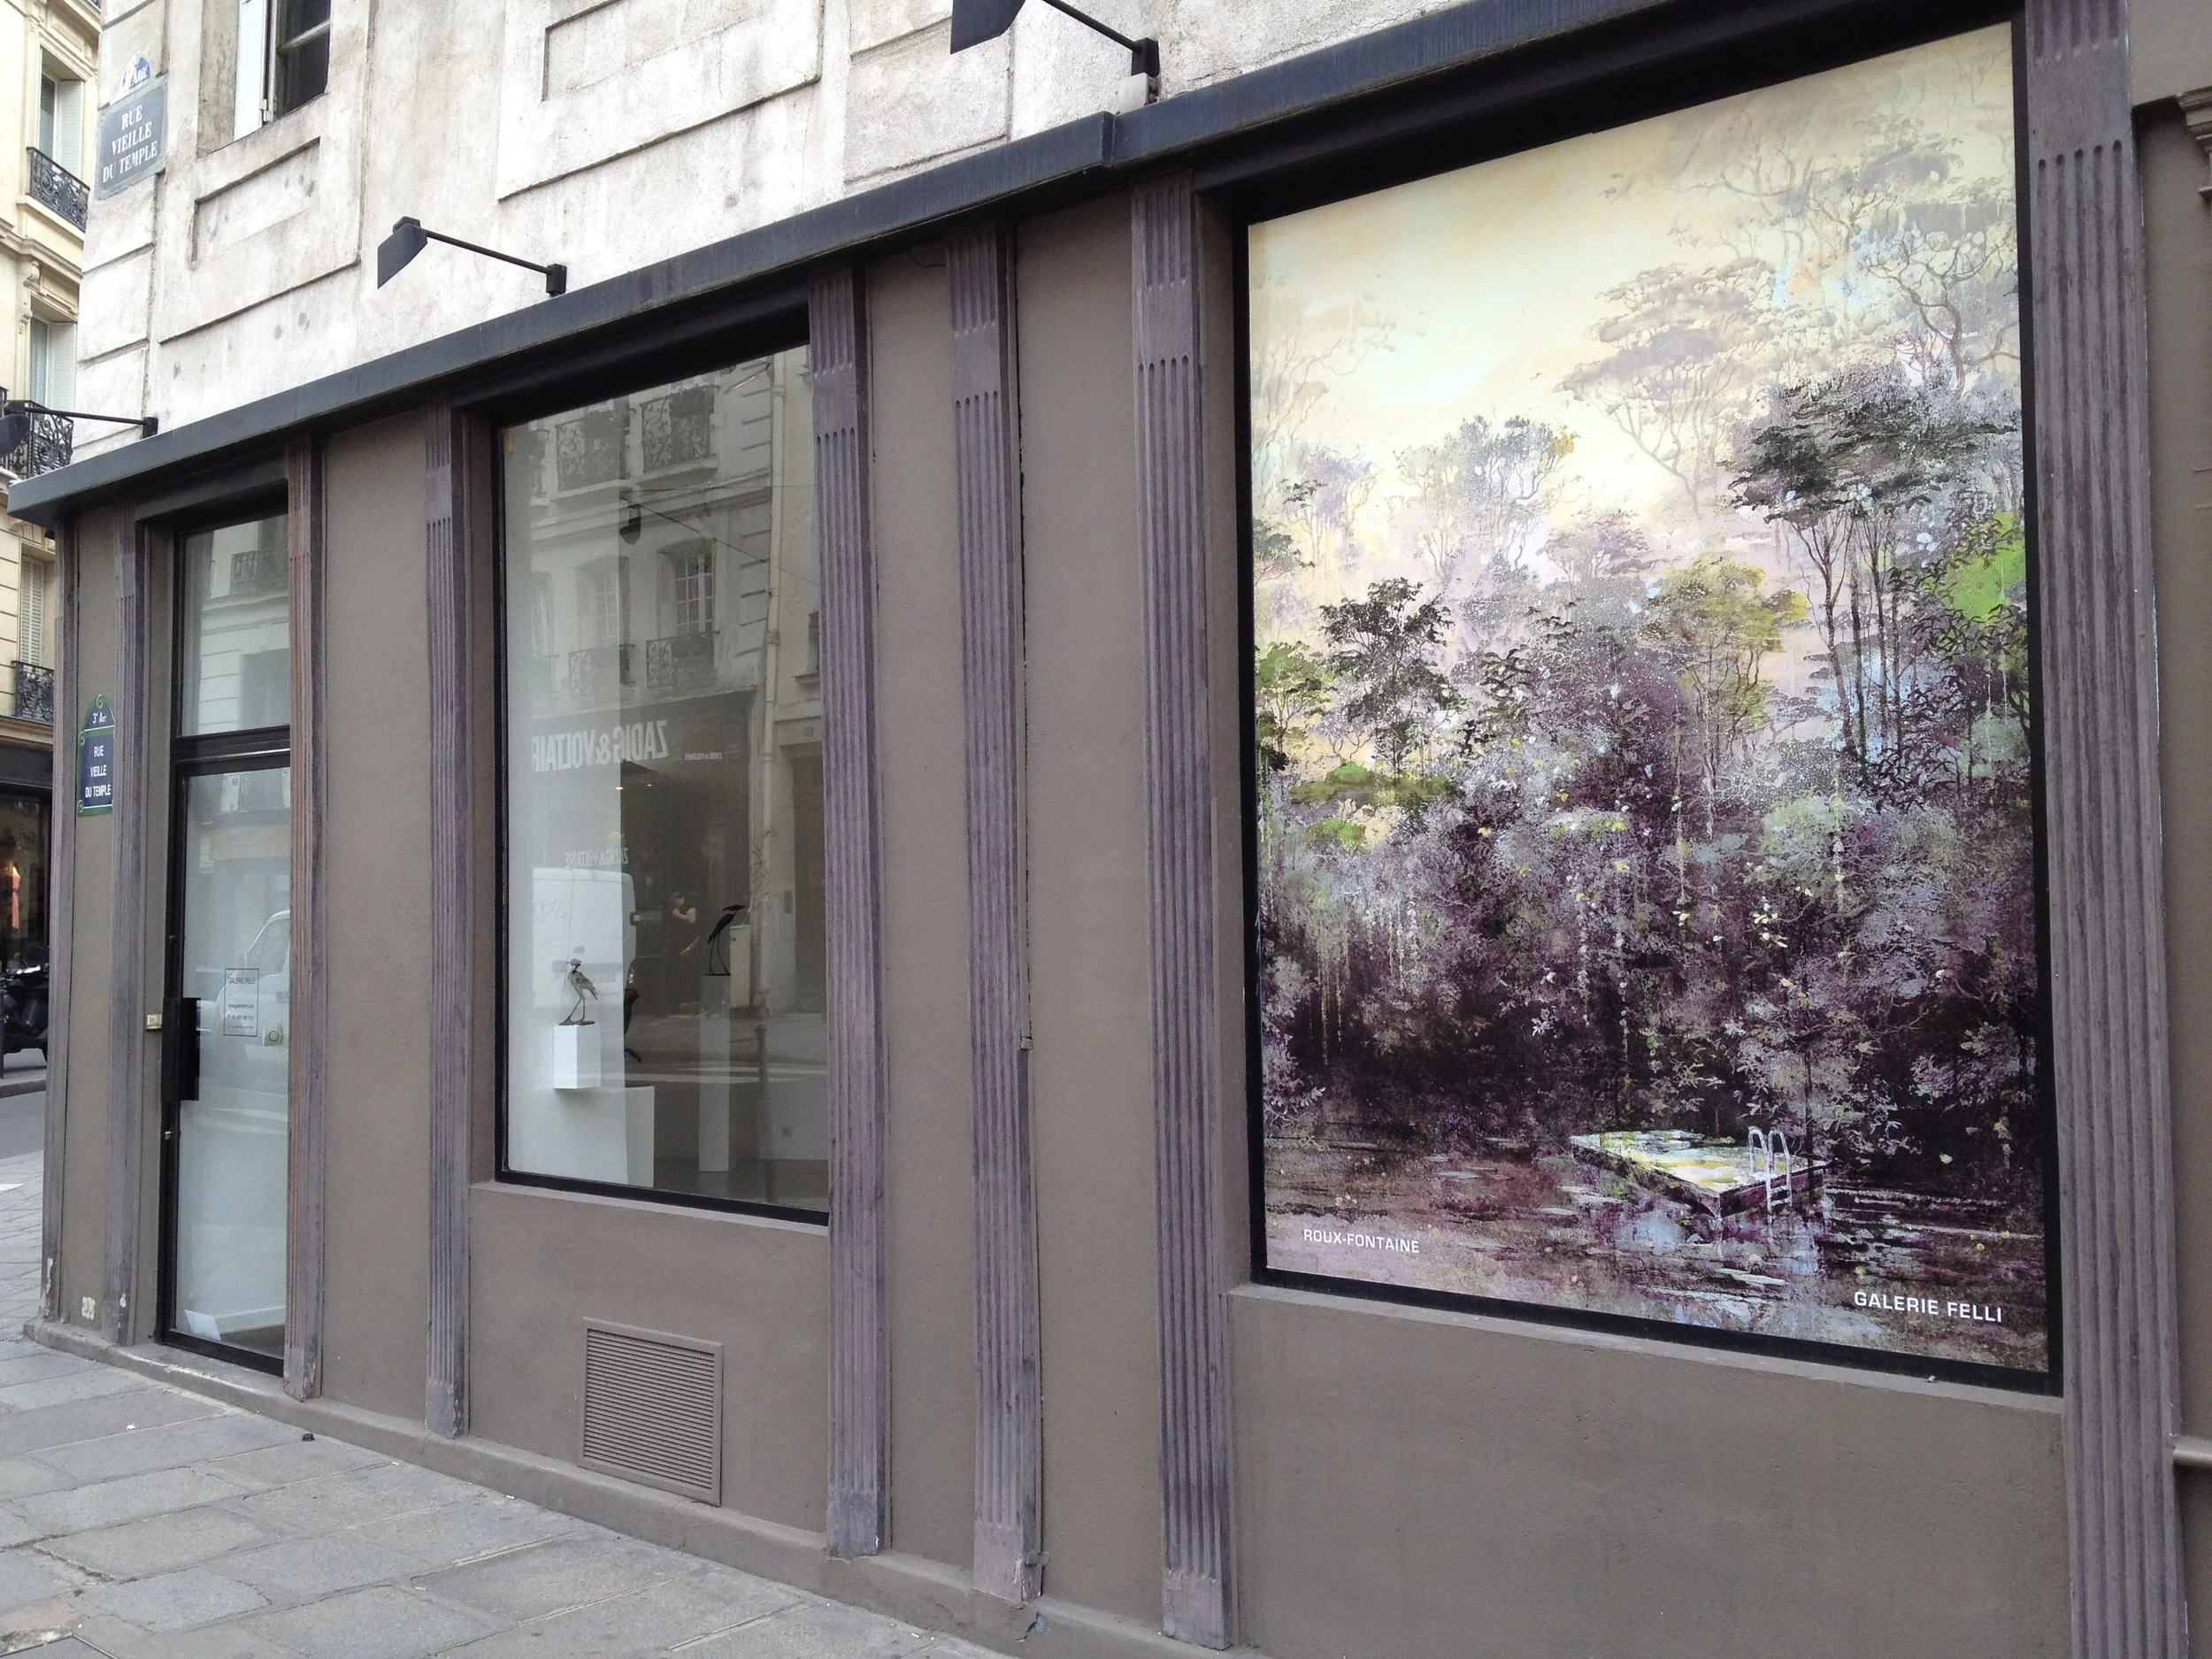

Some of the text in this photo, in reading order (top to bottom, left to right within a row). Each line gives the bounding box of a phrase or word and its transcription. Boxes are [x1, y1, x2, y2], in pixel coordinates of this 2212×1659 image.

[121, 104, 142, 131] RUE
[111, 121, 152, 156] VIEILLE
[103, 141, 157, 183] DU TEMPLE
[94, 745, 104, 757] RUE
[90, 764, 107, 778] VIEILLE
[85, 784, 111, 798] DU TEMPLE
[1303, 1229, 1420, 1253] ROUX-FONTAINE
[1855, 1291, 2001, 1323] GALERIE FELLI
